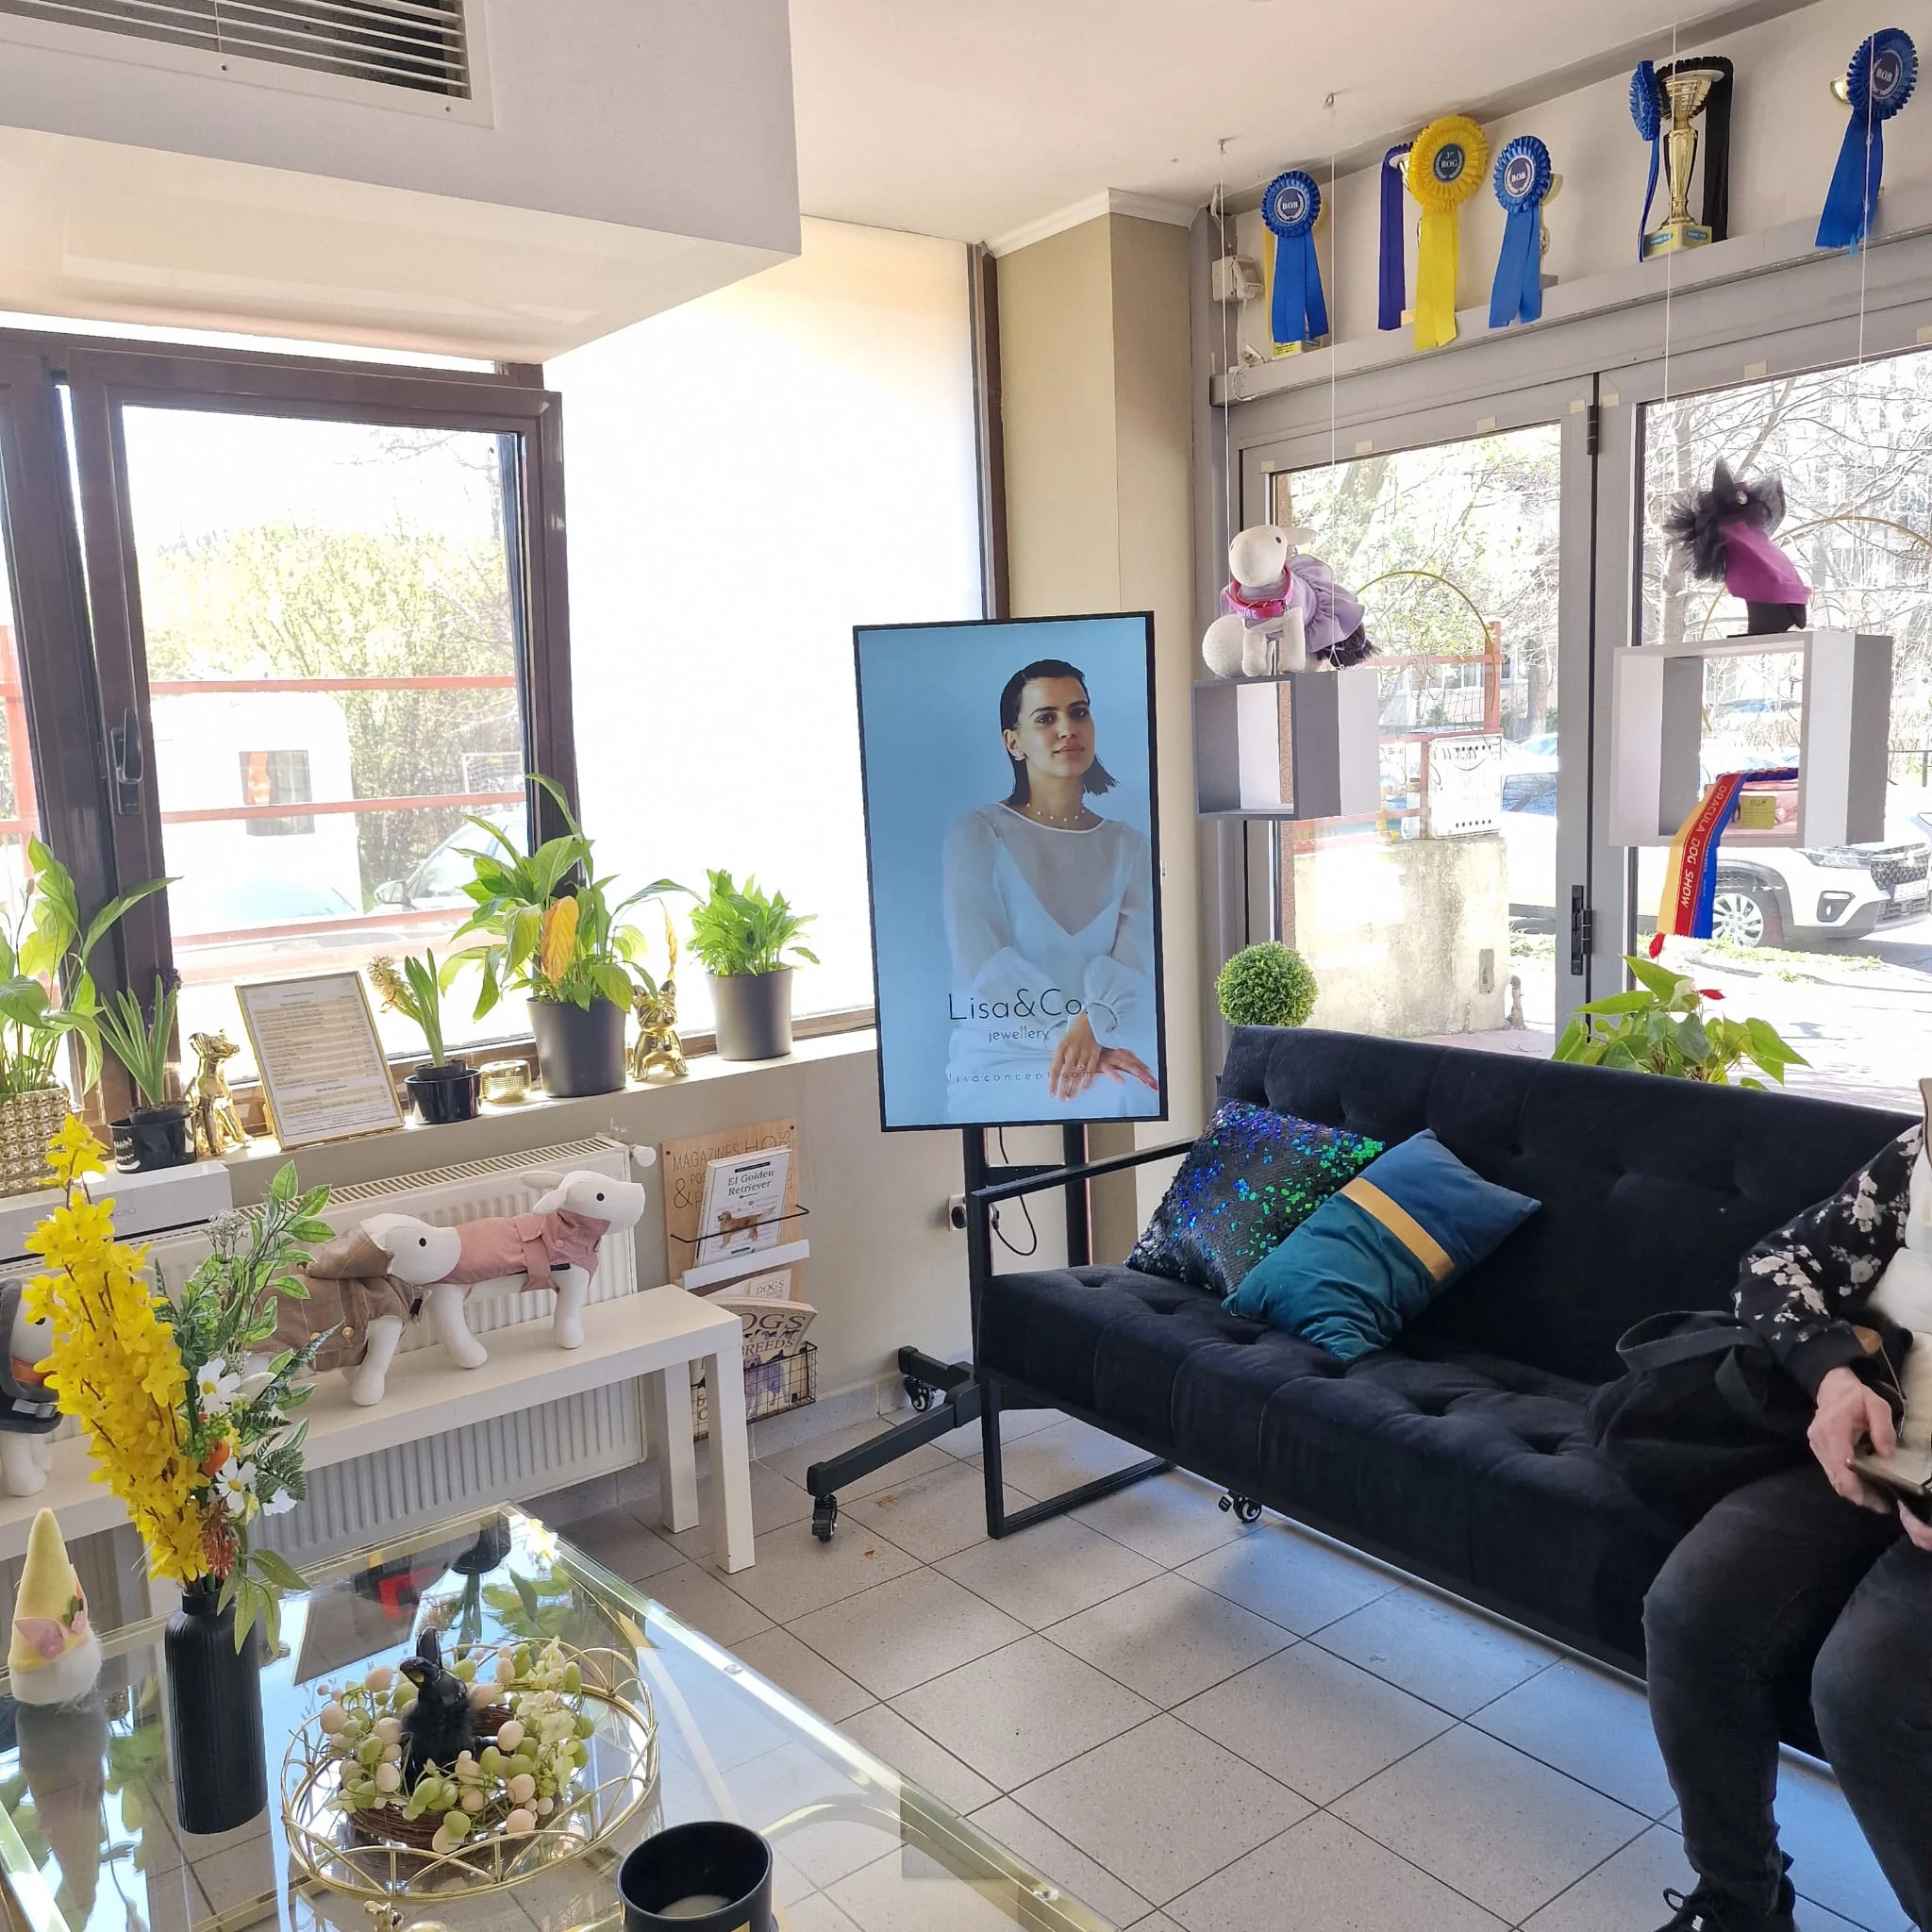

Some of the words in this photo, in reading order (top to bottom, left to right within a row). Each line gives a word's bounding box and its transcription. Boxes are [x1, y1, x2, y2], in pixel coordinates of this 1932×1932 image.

[1696, 785, 1727, 832] DRACULA
[1687, 838, 1701, 865] DOG
[1680, 869, 1694, 908] SHOW
[989, 1025, 1049, 1043] jewellery
[673, 1143, 741, 1171] MAGAZINES
[727, 1176, 738, 1186] El
[741, 1170, 774, 1184] Golden
[727, 1179, 773, 1196] Retriever
[756, 1280, 785, 1295] DOGS
[739, 1312, 806, 1331] OGS
[741, 1340, 794, 1357] REEDS
